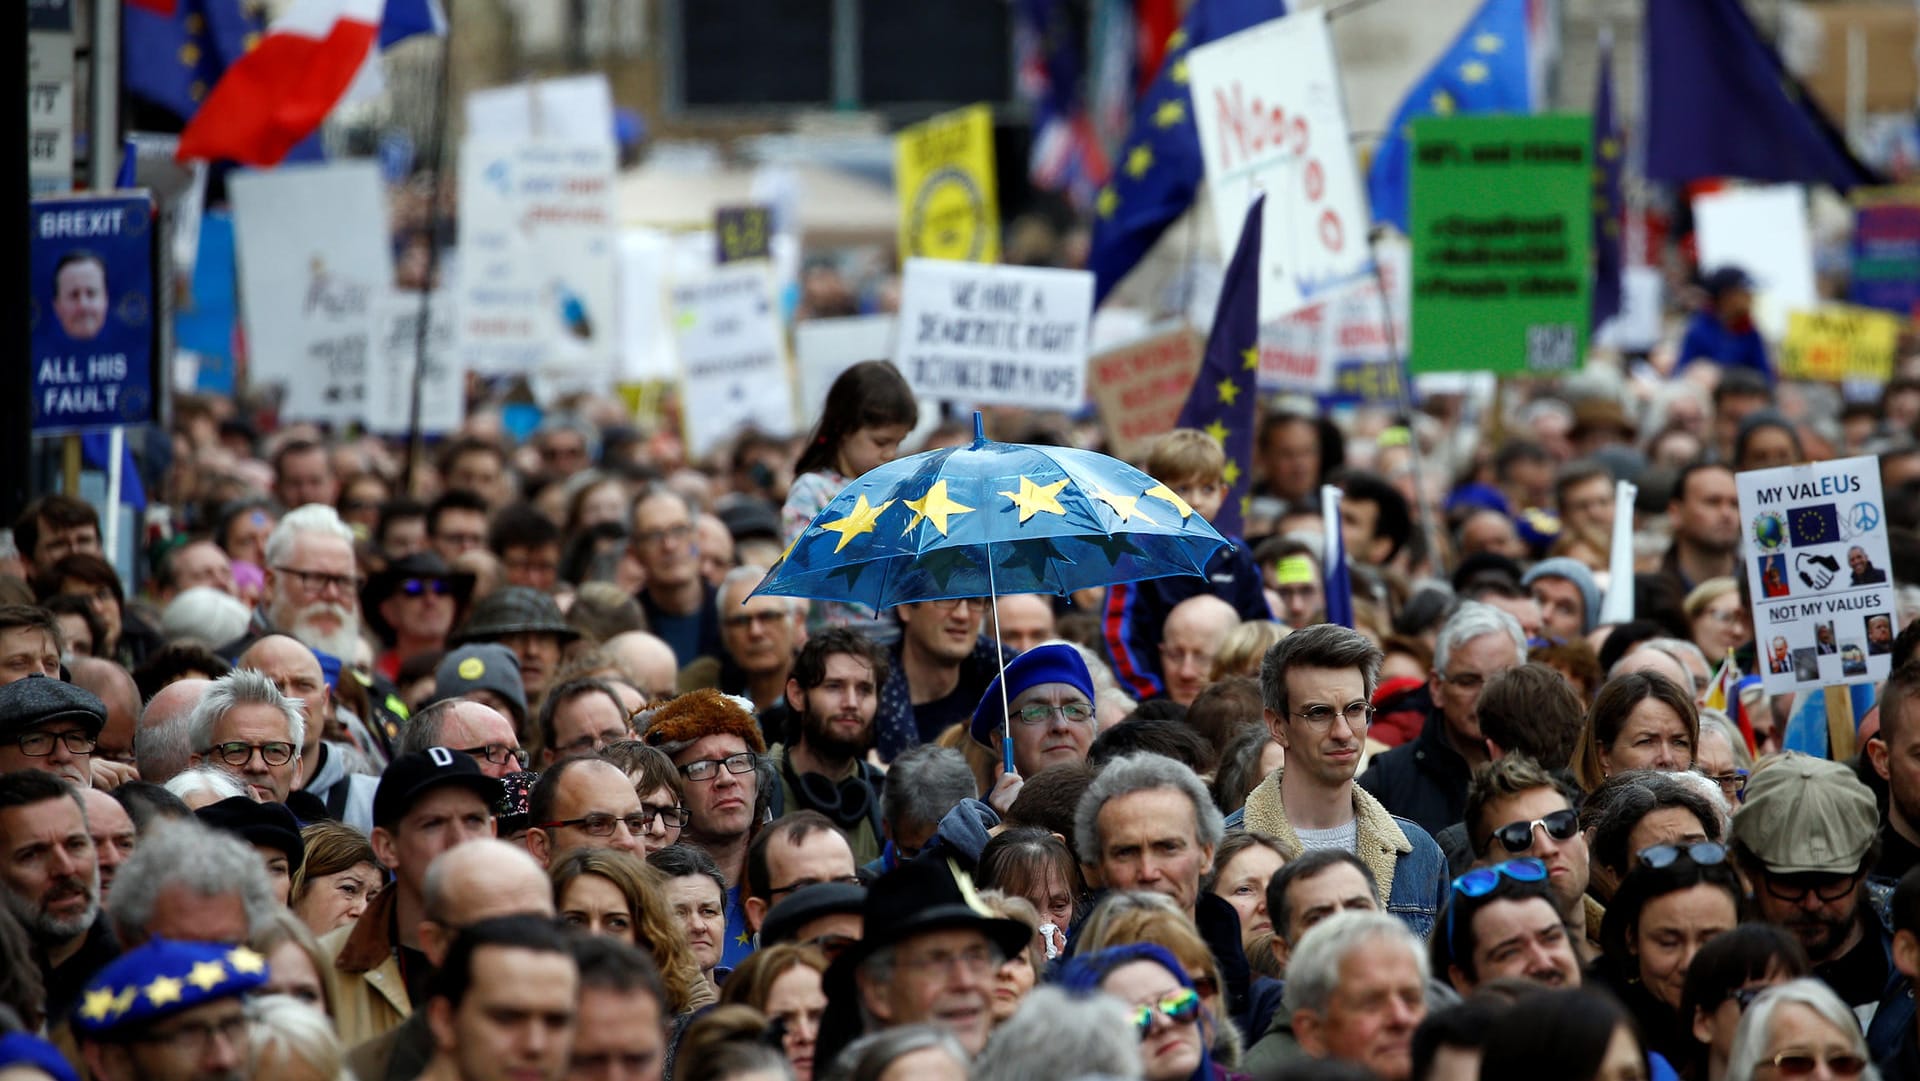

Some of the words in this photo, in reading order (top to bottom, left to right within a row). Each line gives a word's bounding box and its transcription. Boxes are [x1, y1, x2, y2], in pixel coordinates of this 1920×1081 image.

[39, 207, 124, 238] BREXIT
[38, 357, 81, 384] ALL
[88, 353, 127, 382] HIS
[44, 383, 120, 414] FAULT
[1757, 487, 1782, 505] MY
[1769, 605, 1797, 620] NOT
[1801, 602, 1822, 617] MY
[1827, 594, 1881, 613] VALUES
[428, 746, 453, 767] D
